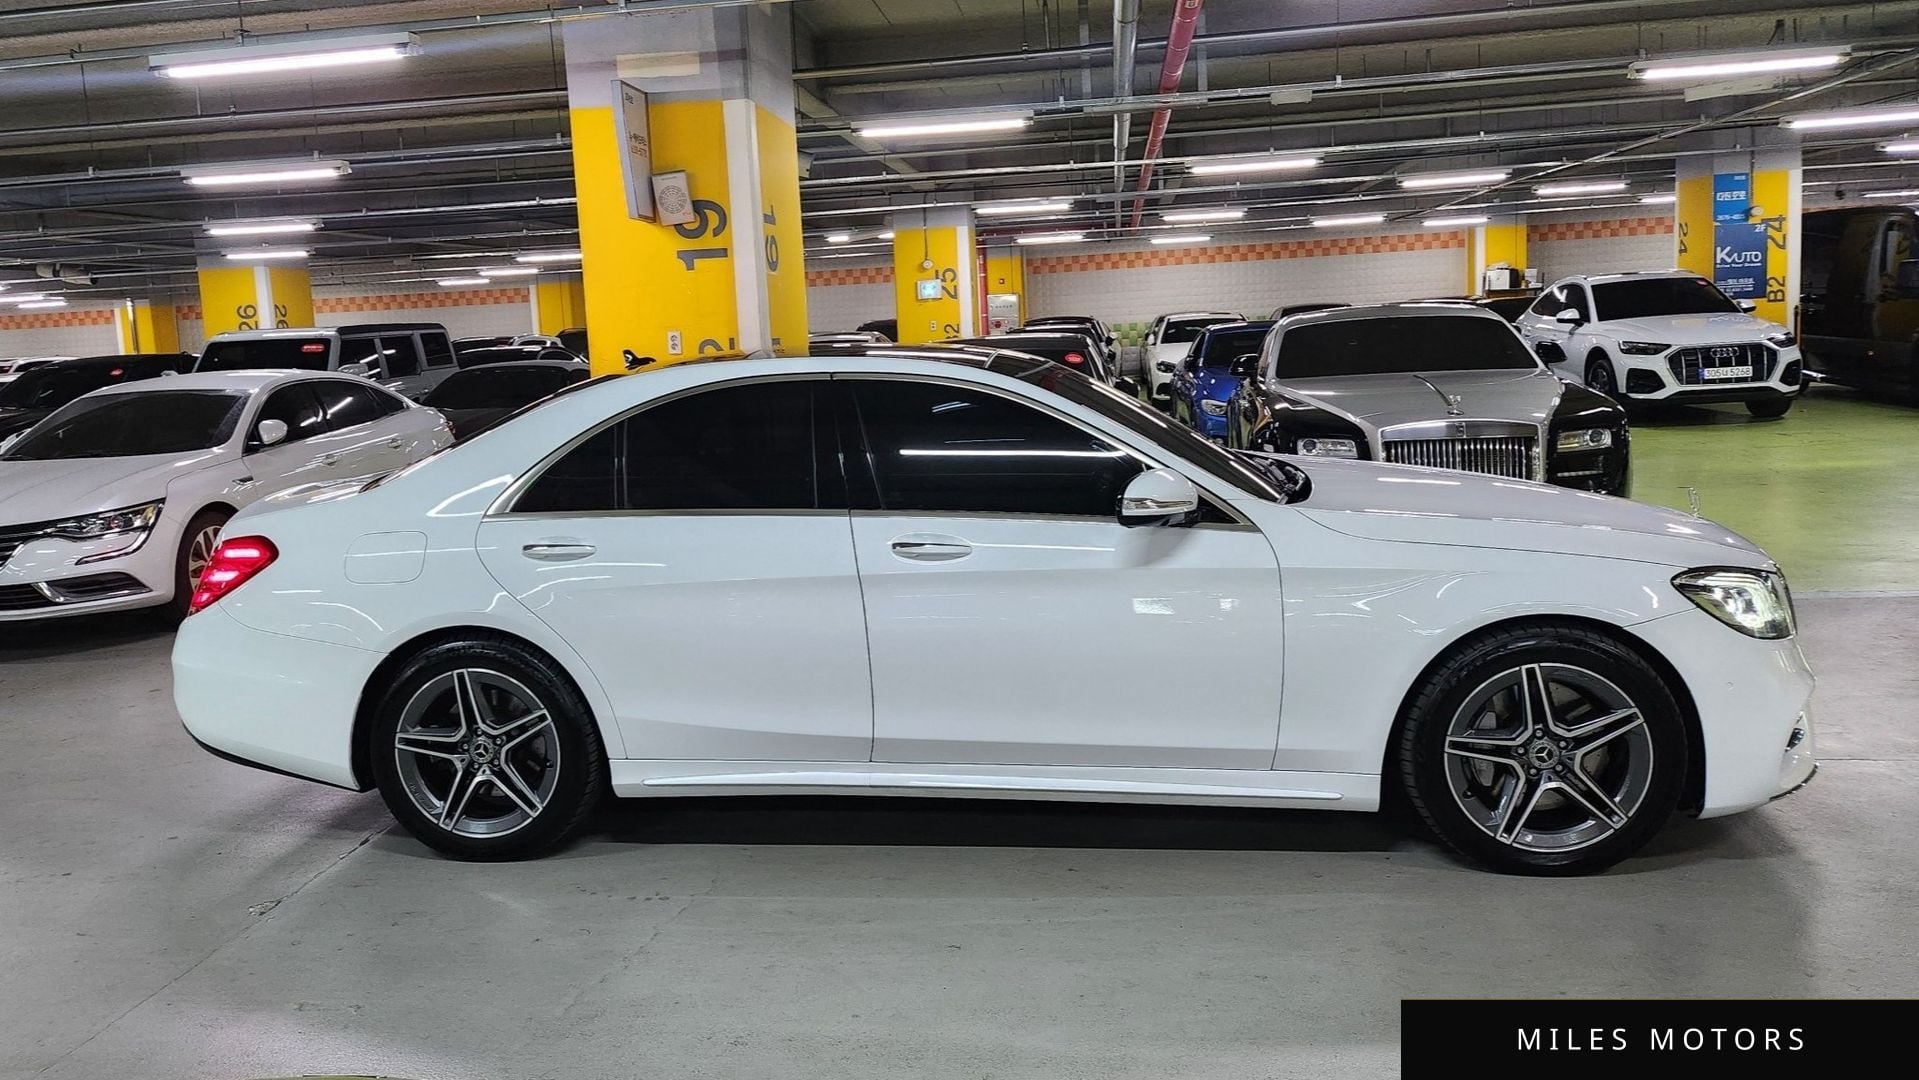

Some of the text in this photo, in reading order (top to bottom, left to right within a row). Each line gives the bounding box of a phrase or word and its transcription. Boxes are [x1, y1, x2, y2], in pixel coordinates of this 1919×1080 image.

[674, 200, 728, 271] 19
[763, 205, 778, 272] 19
[1679, 222, 1688, 256] 24
[1761, 215, 1785, 303] B2 24
[935, 268, 958, 299] 25
